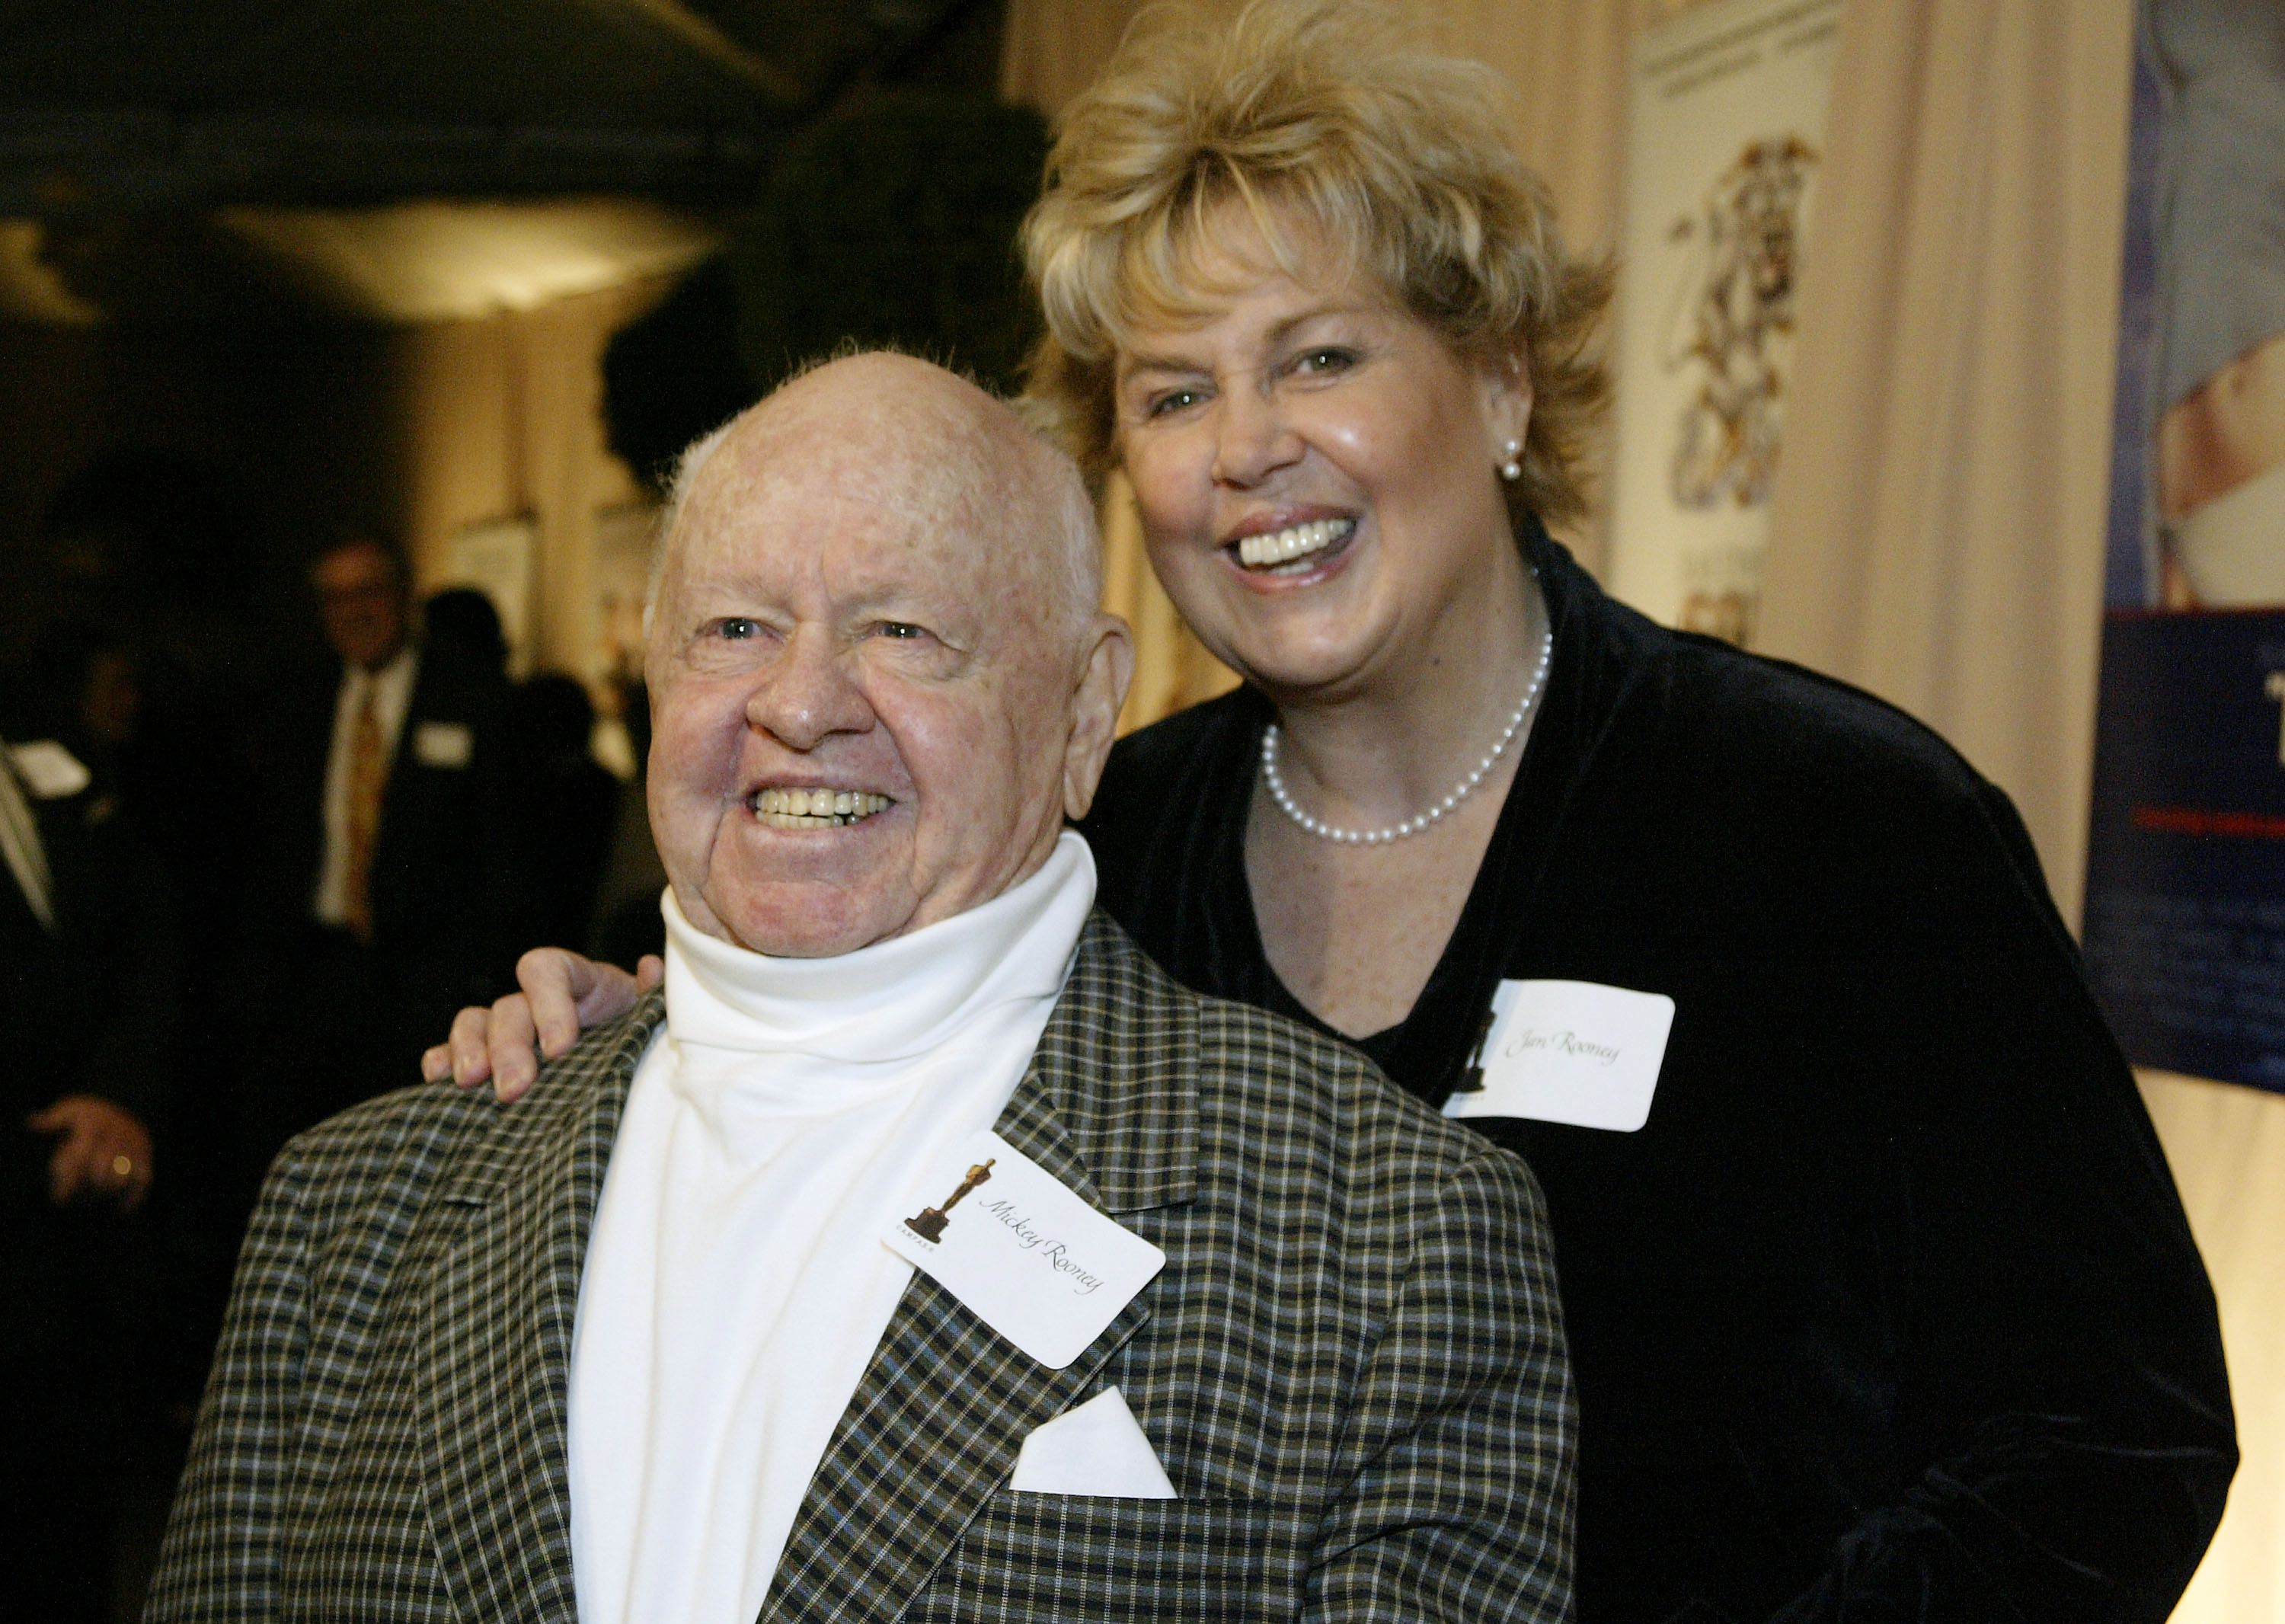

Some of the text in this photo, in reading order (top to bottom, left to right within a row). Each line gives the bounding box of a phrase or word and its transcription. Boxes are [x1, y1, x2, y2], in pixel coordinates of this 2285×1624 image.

[1506, 1029, 1622, 1065] Jan Rooney
[980, 1200, 1105, 1295] Mickey Rooney
